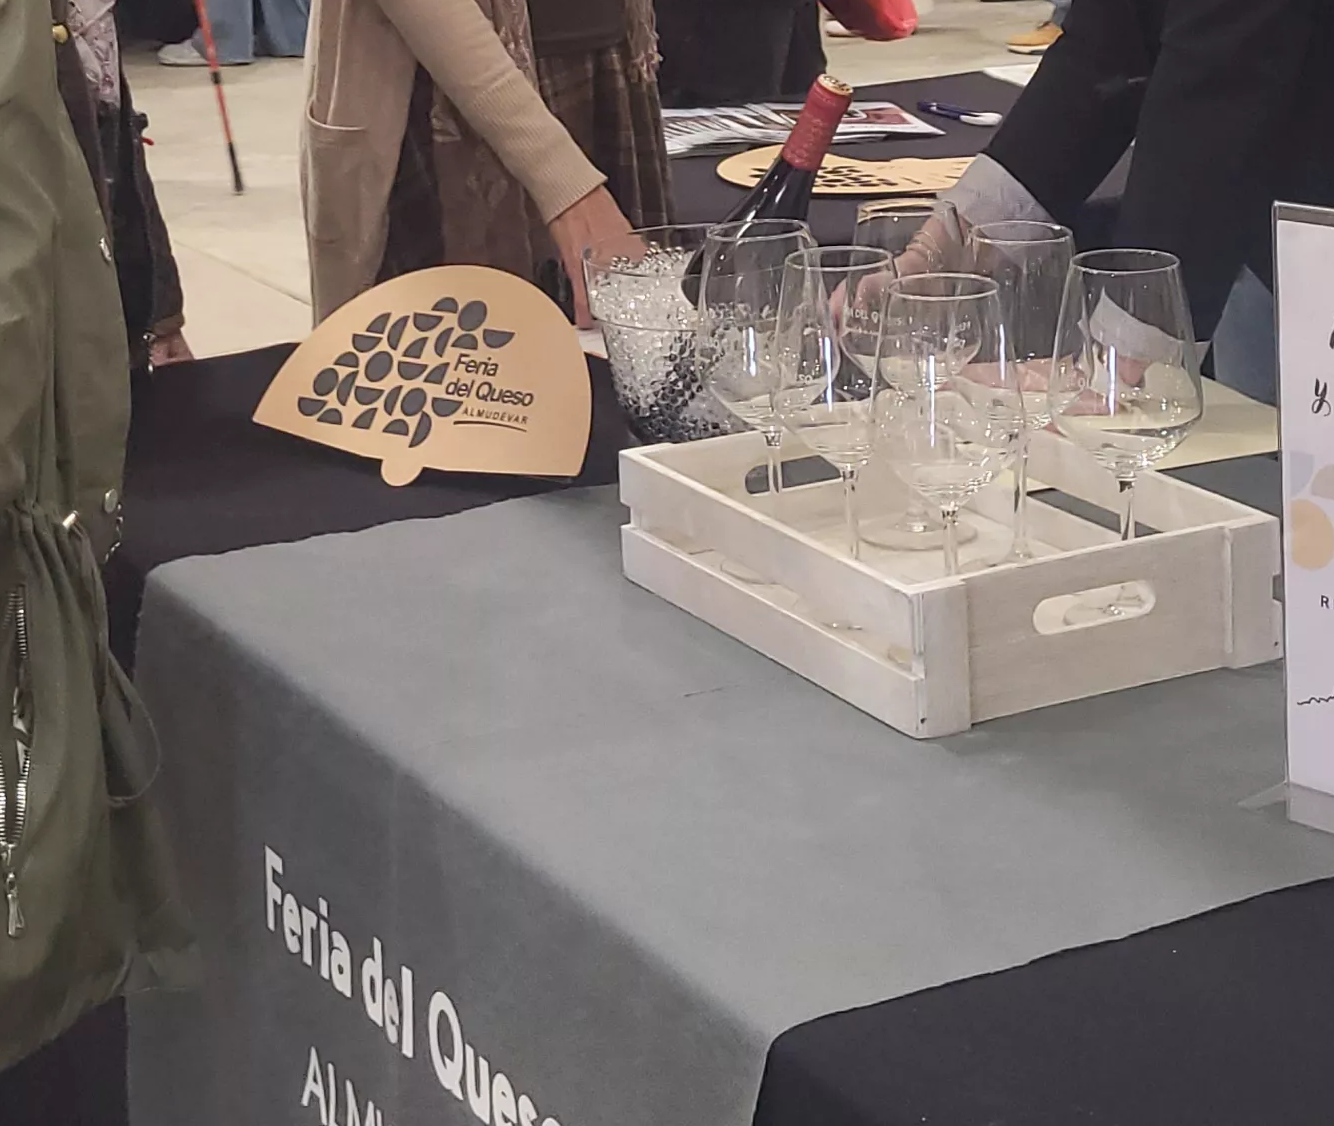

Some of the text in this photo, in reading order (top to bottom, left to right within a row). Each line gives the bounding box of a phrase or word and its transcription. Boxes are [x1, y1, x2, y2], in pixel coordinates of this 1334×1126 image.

[453, 352, 500, 377] Feria
[444, 377, 535, 407] del Queso
[1311, 377, 1332, 417] y
[264, 844, 353, 999] Feria
[361, 935, 415, 1060] del
[427, 989, 563, 1126] Ques
